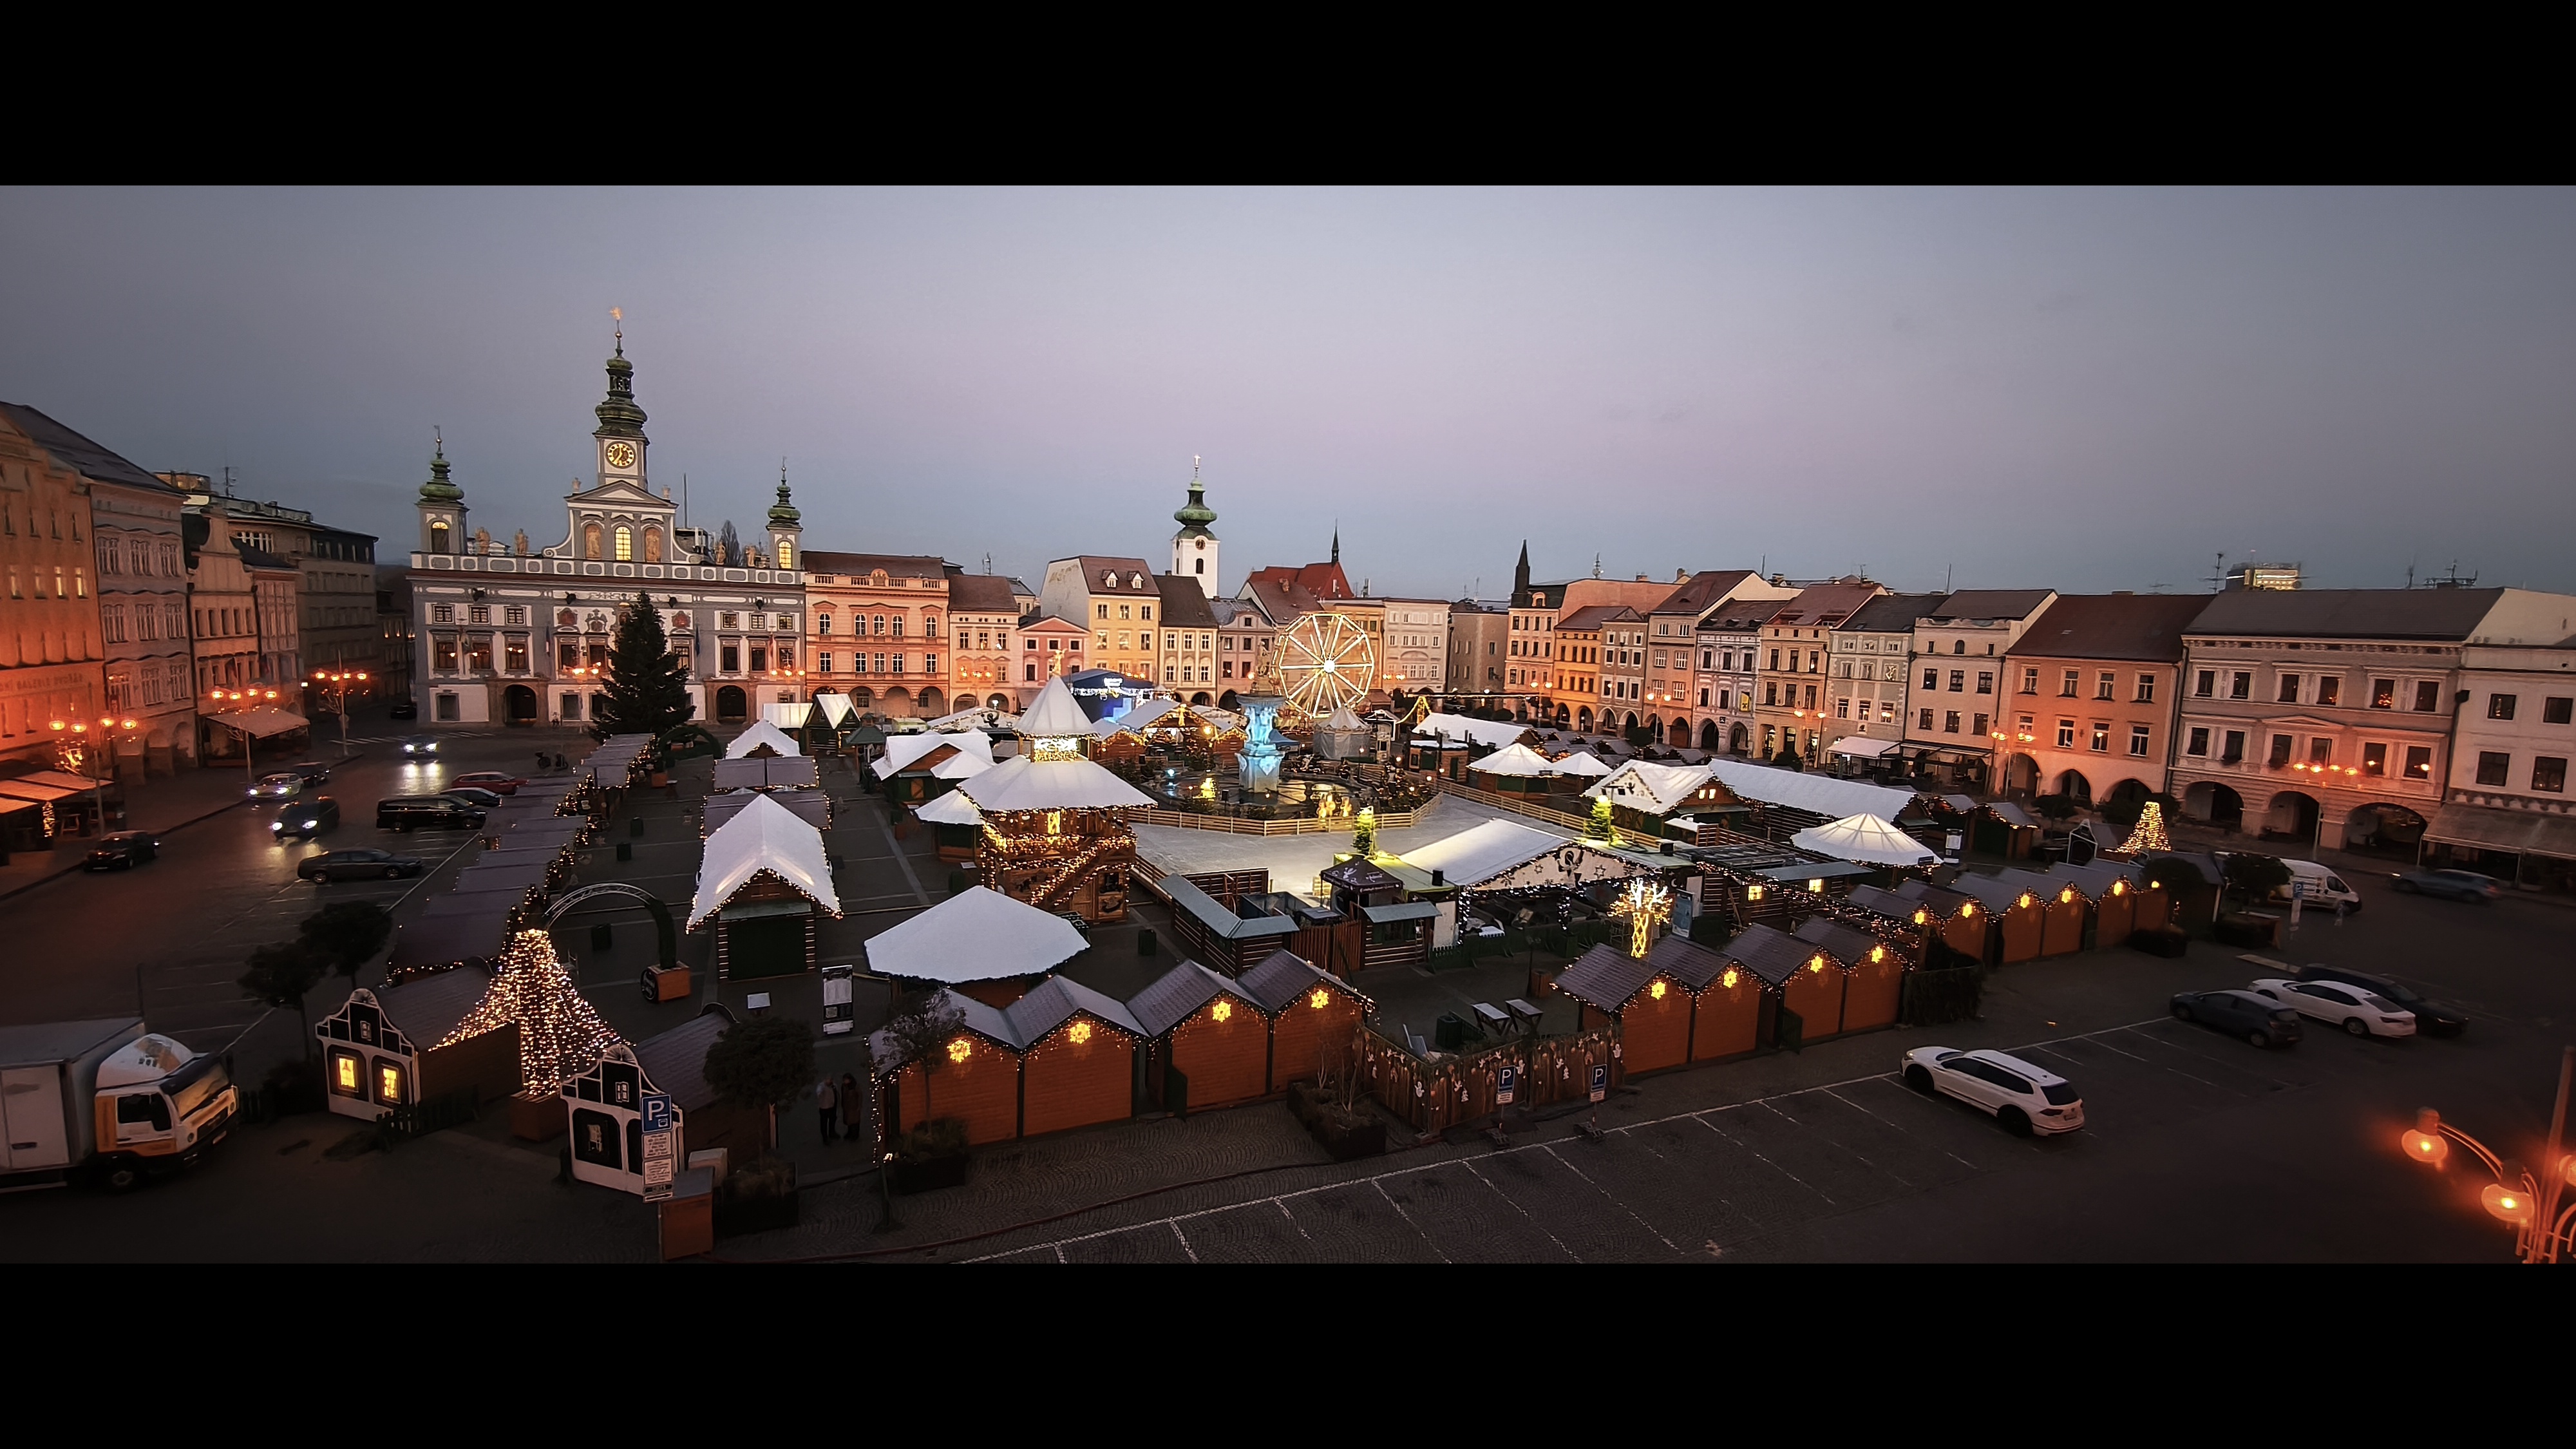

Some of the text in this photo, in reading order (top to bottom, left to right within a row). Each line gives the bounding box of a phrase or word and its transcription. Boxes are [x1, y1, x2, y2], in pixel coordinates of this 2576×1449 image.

[1502, 1069, 1511, 1084] P
[1595, 1068, 1604, 1083] P
[648, 1100, 665, 1121] P
